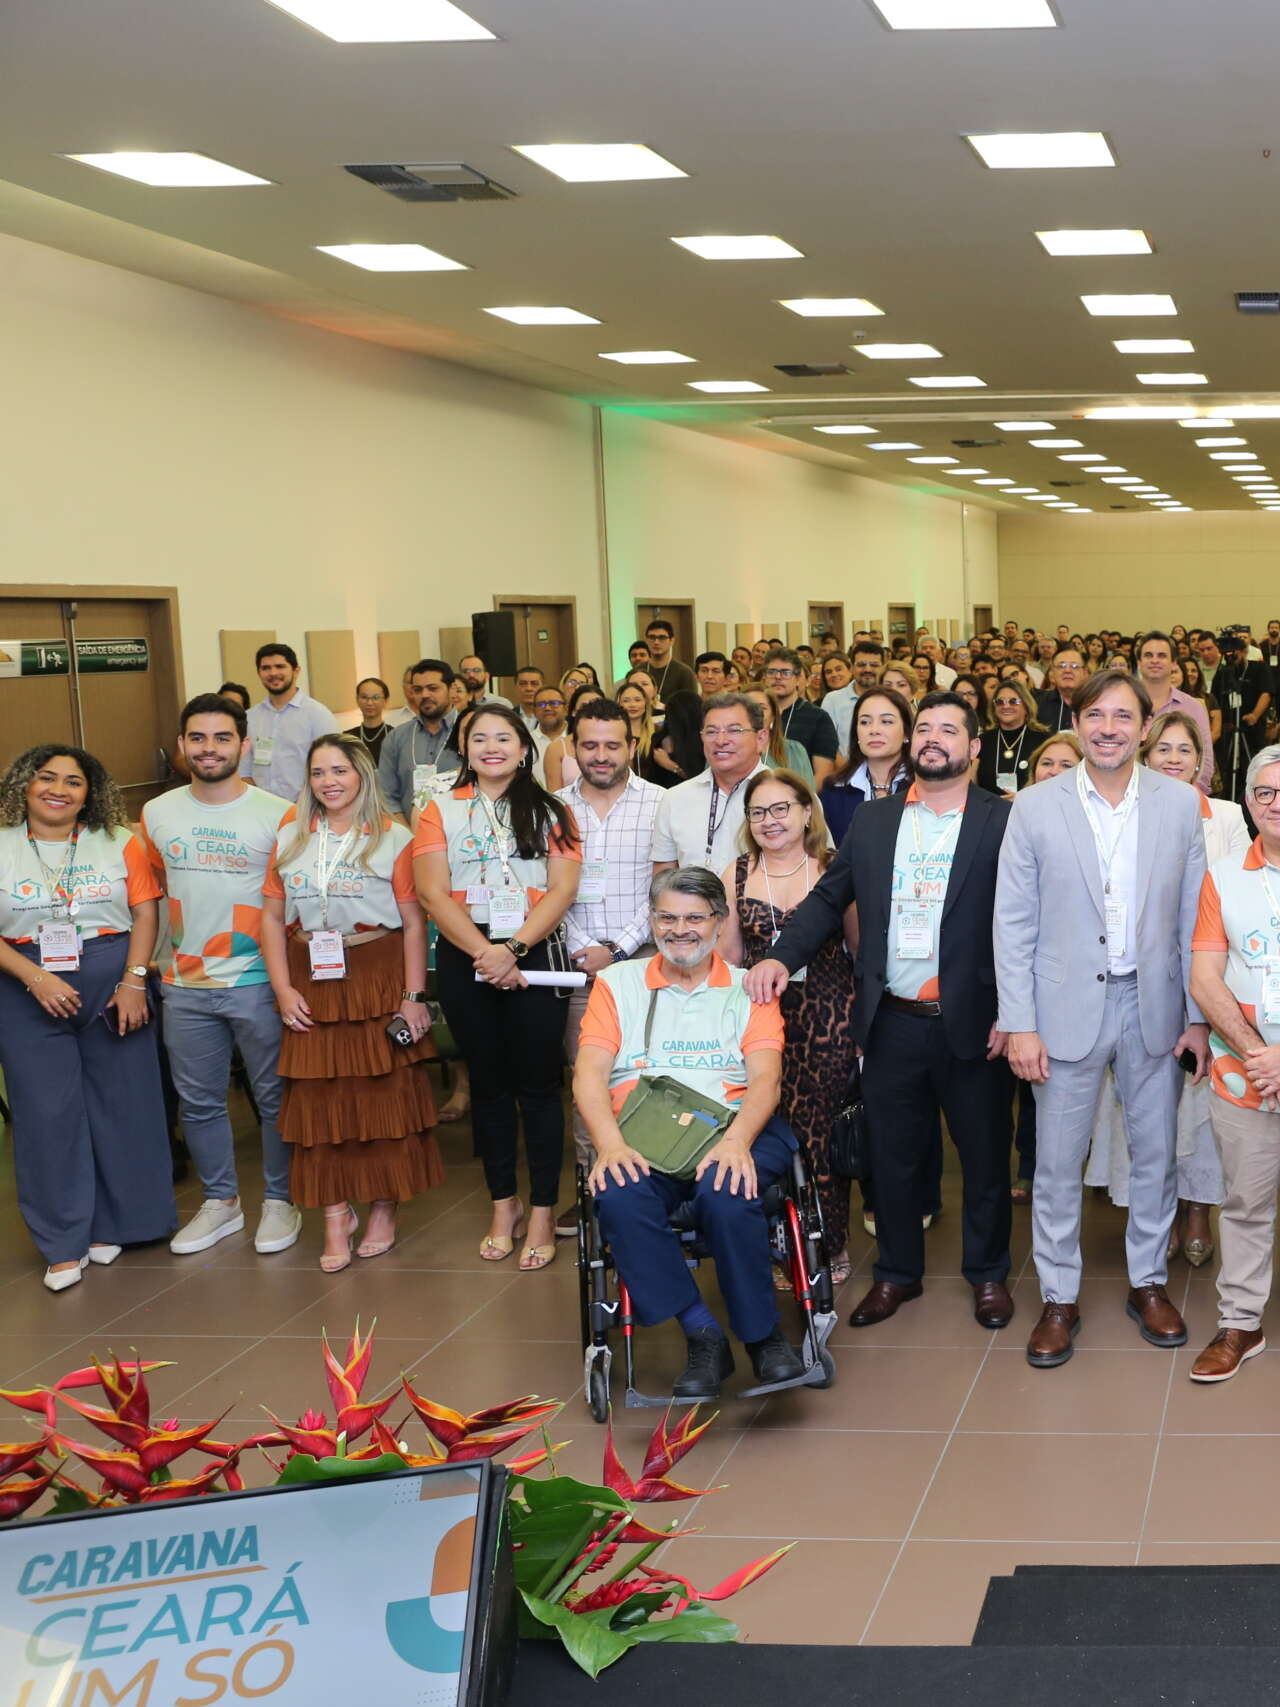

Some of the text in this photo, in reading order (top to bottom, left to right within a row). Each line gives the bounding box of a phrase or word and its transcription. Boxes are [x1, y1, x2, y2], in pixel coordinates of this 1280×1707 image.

[191, 827, 237, 840] CARAVANA
[197, 853, 222, 866] UM
[913, 867, 947, 881] CEA
[662, 1039, 721, 1052] CARAVANA
[17, 1525, 259, 1596] CARAVANA
[25, 1561, 310, 1668] CEARÁ
[175, 1623, 295, 1707] SÓ
